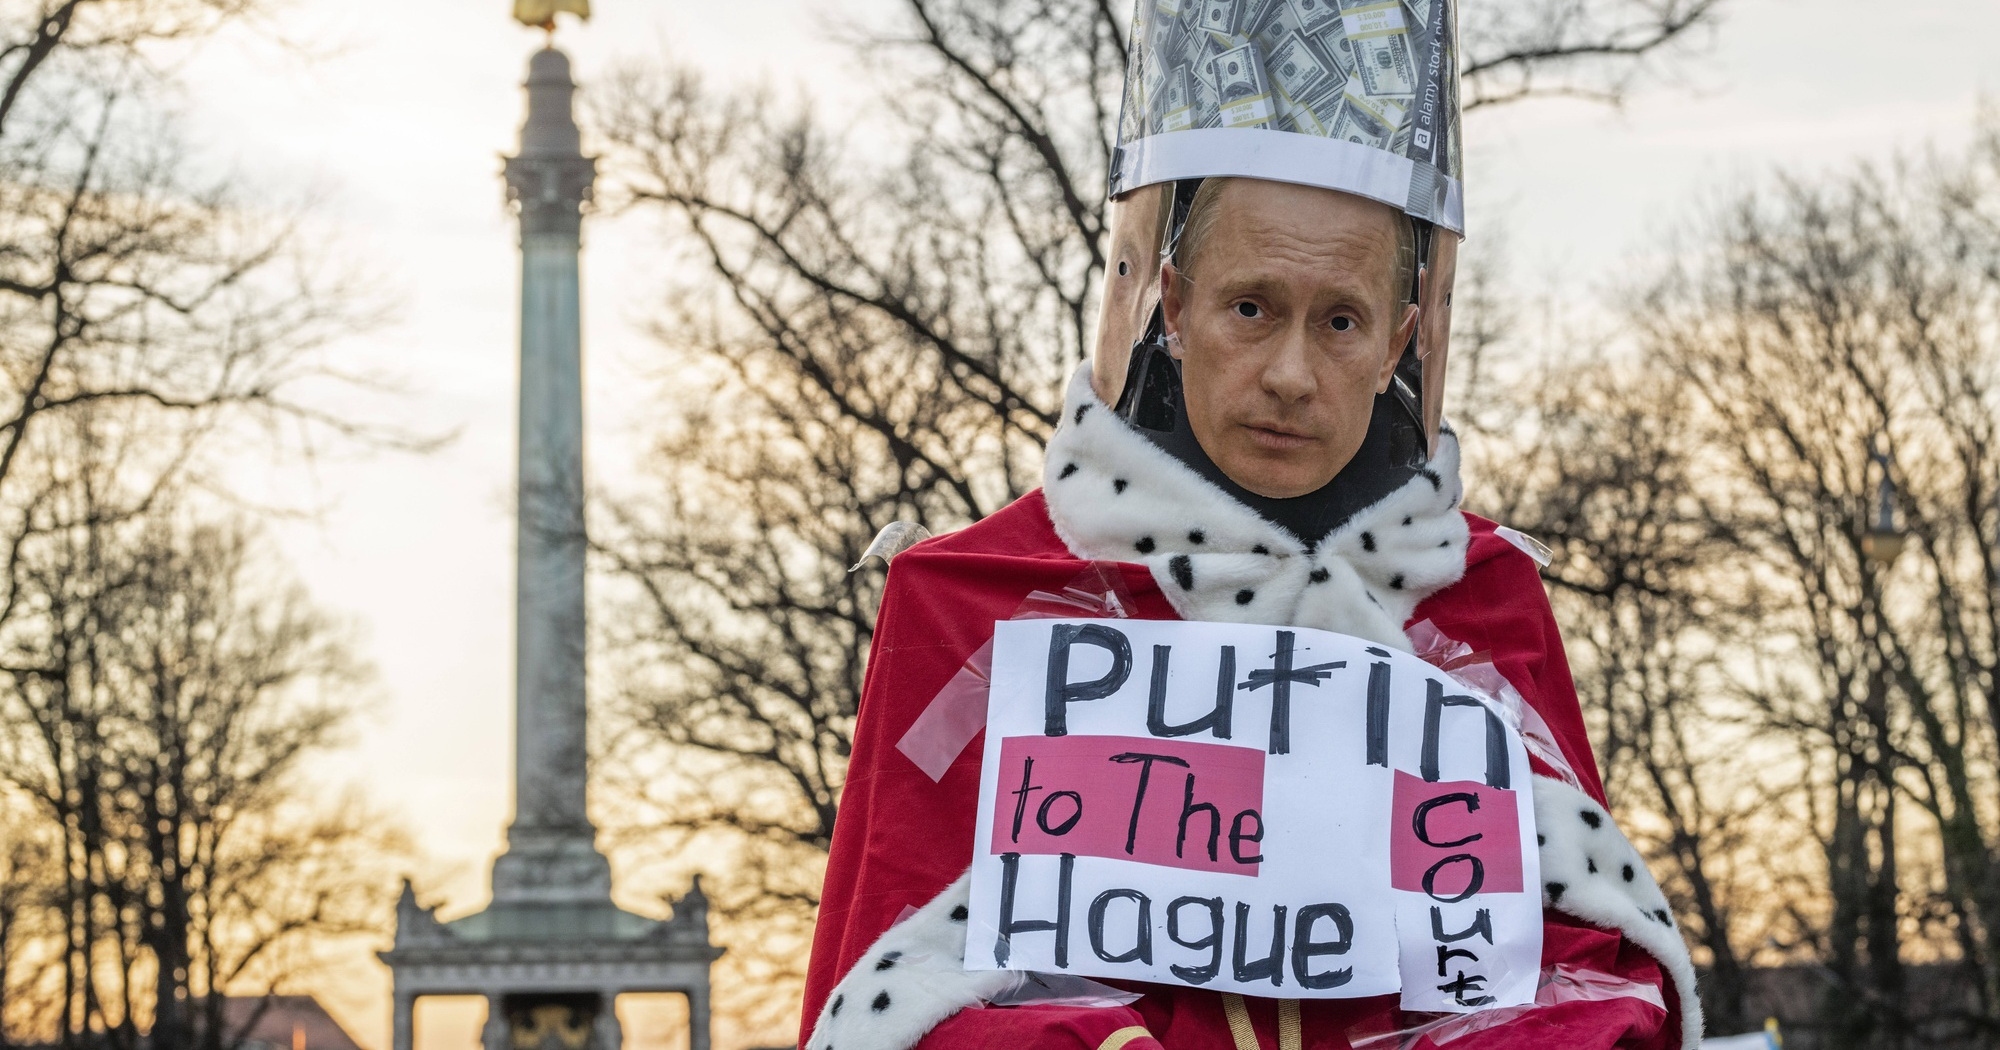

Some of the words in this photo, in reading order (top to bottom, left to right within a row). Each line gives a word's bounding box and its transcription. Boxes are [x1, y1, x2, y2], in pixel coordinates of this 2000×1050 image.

[1418, 78, 1439, 126] alamy
[1427, 38, 1441, 77] stock
[1044, 623, 1511, 791] Putin
[1011, 756, 1083, 844] to
[1108, 752, 1264, 864] The
[994, 852, 1355, 990] Hague
